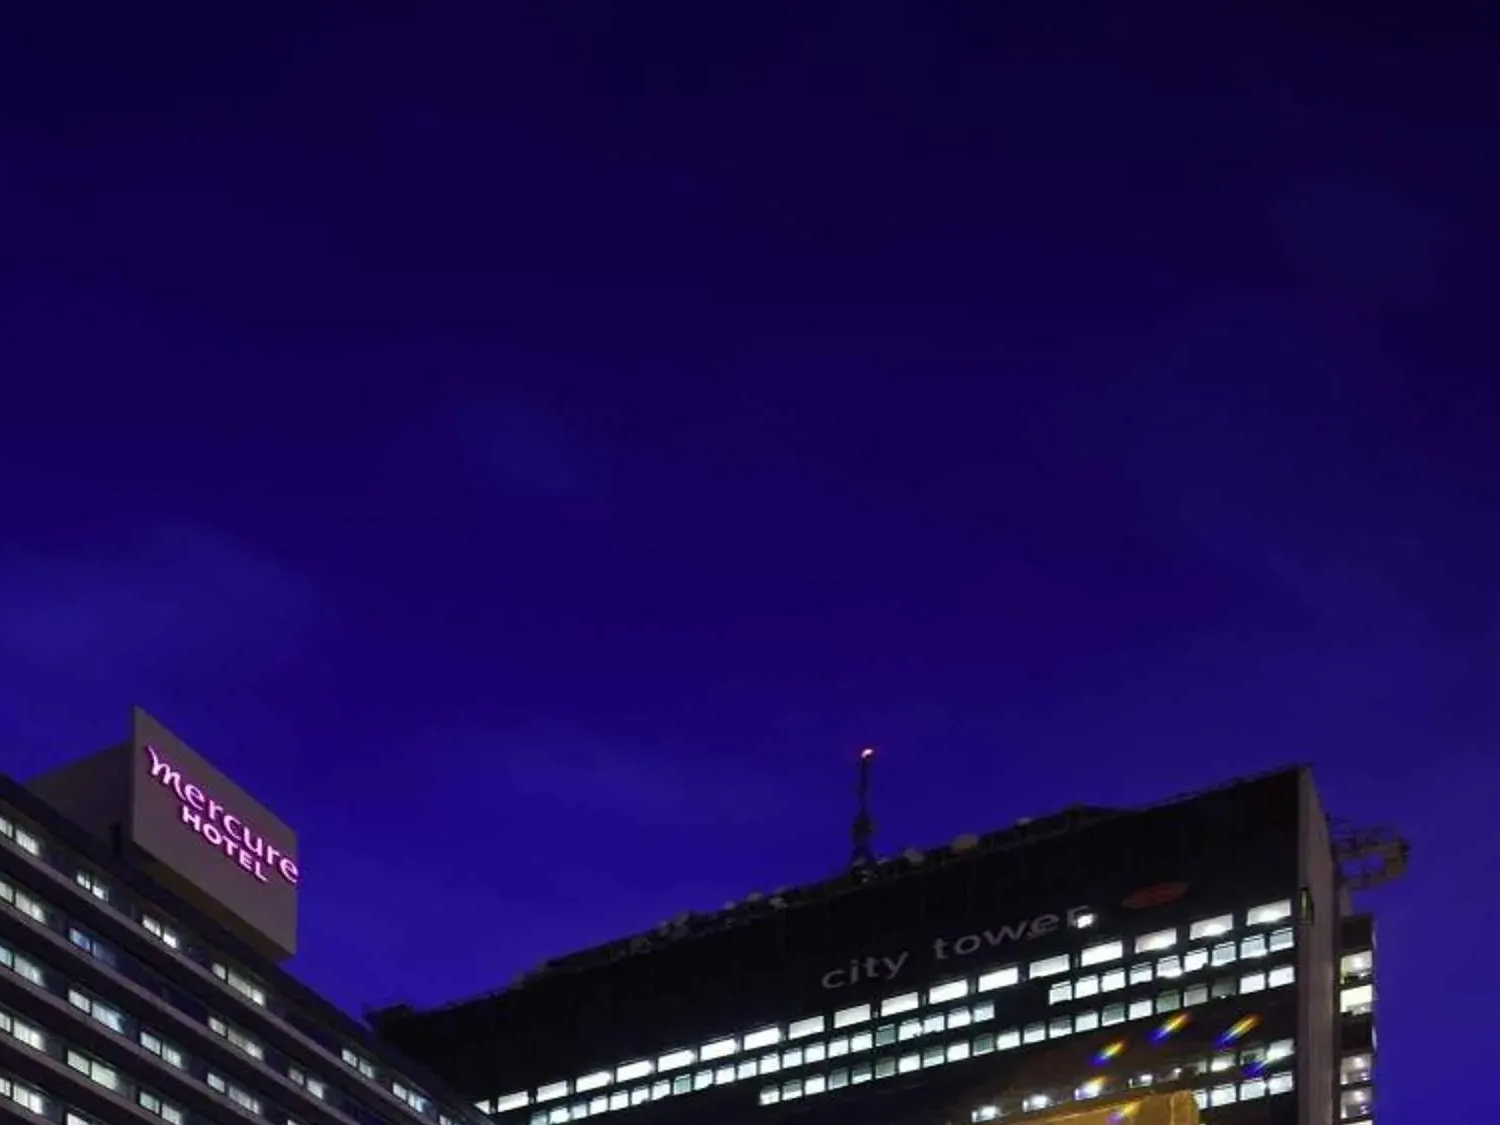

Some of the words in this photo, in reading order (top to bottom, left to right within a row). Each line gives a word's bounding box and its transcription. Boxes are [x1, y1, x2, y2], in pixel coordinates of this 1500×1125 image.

[181, 805, 268, 883] HOTEL
[821, 950, 910, 990] city
[932, 904, 1096, 961] tower
